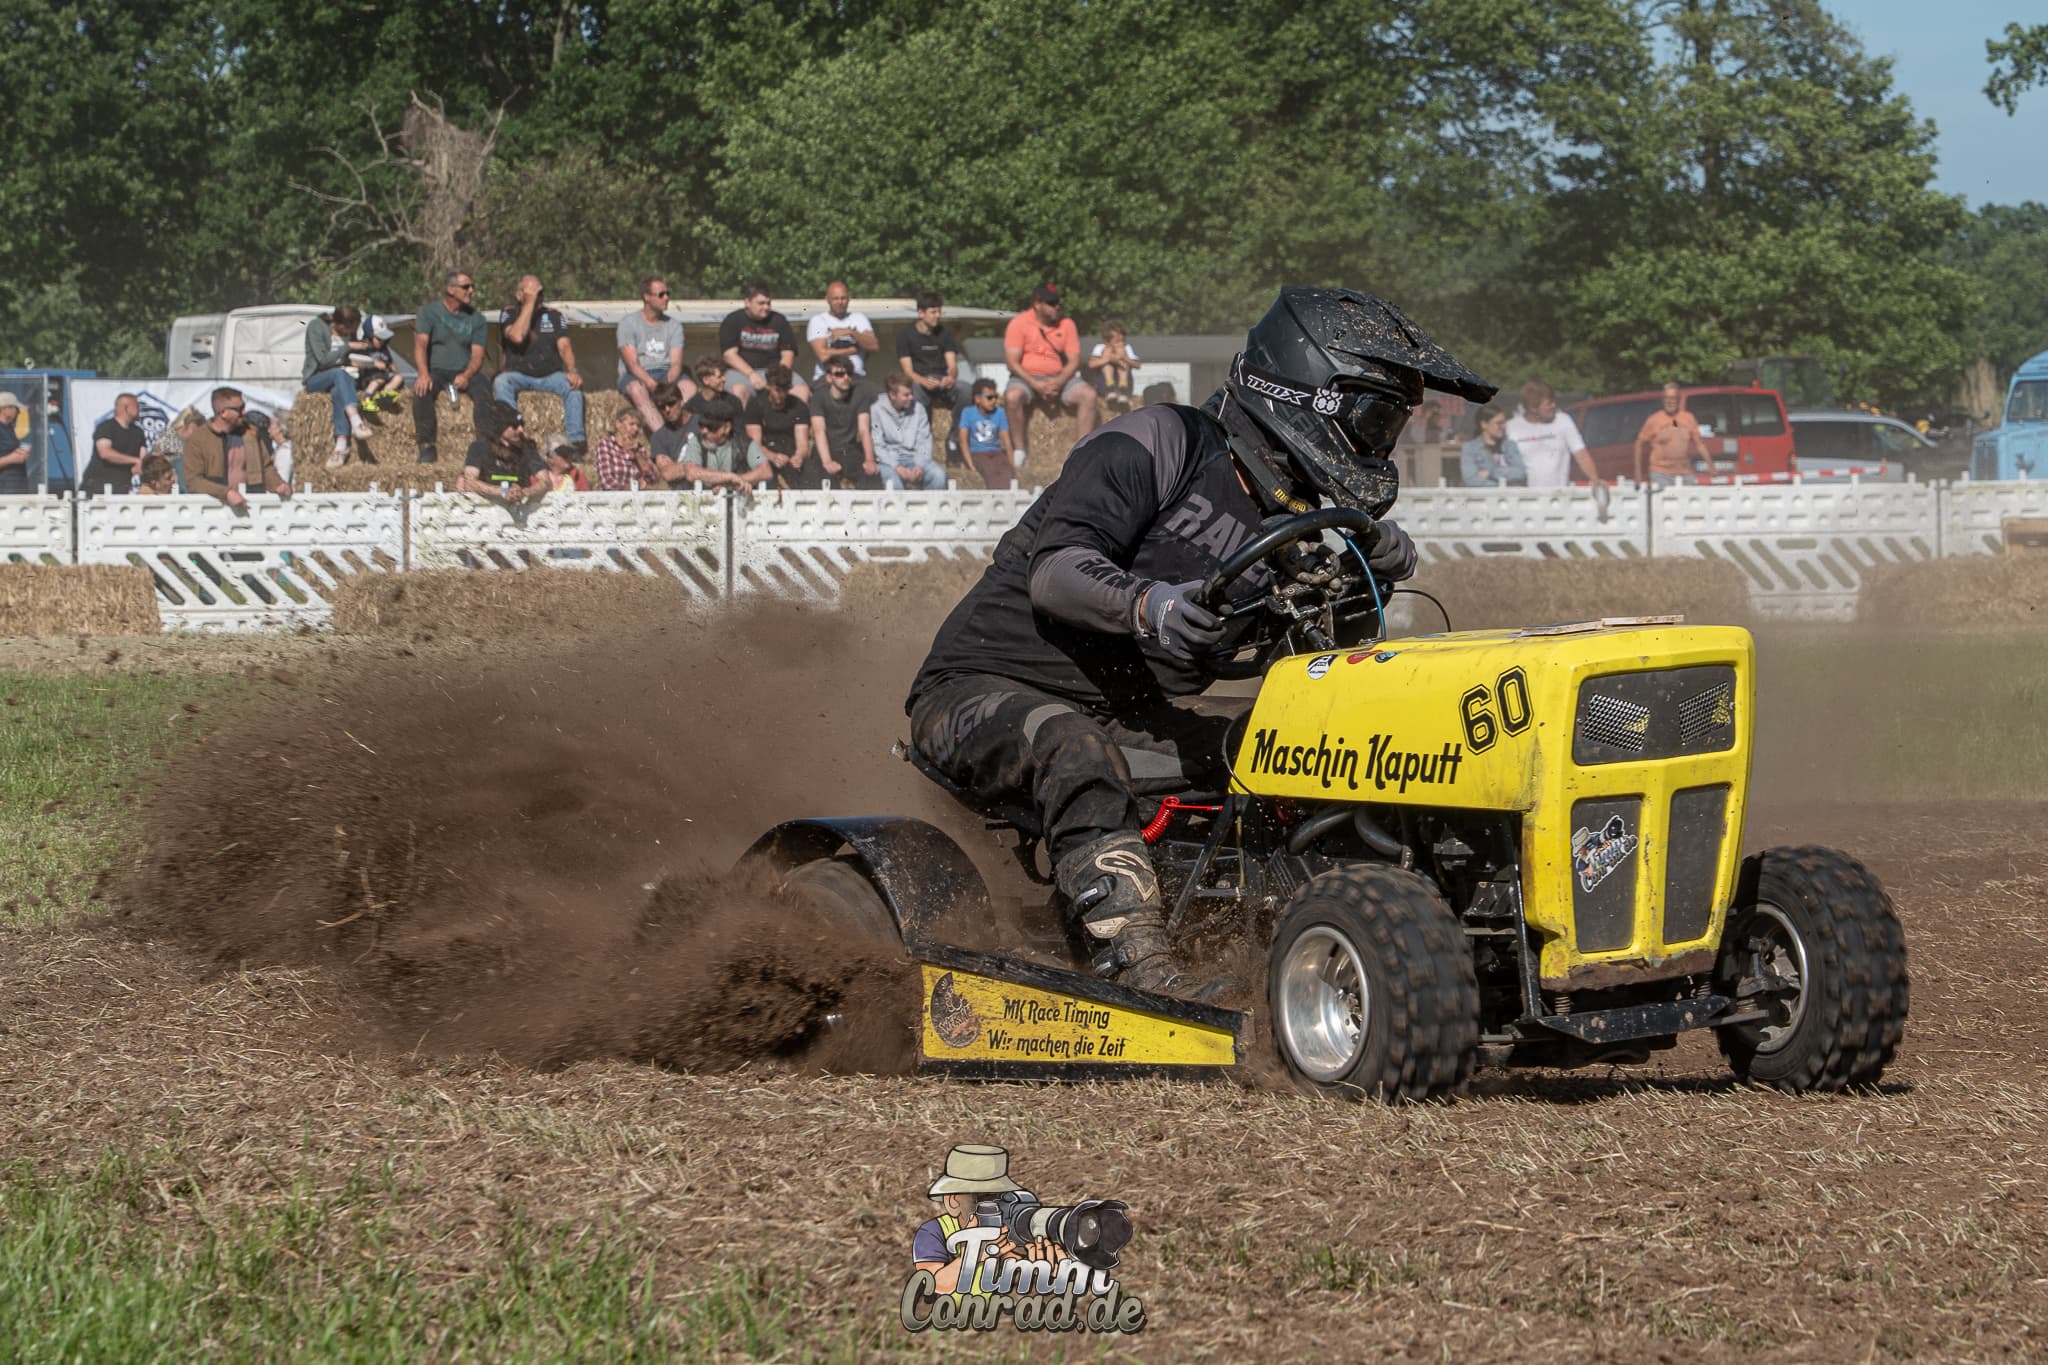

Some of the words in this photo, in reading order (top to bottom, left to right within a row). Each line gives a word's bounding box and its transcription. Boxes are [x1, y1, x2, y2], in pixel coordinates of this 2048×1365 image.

[1458, 665, 1535, 756] 60
[1250, 728, 1359, 790] Maschin
[1364, 733, 1463, 794] Kaputt
[1003, 999, 1025, 1025] MK
[1027, 1000, 1061, 1025] Race
[1063, 1001, 1111, 1030] Timing
[986, 1028, 1013, 1051] Wir
[1015, 1033, 1071, 1058] machen
[1073, 1035, 1095, 1057] die
[1098, 1035, 1127, 1057] Zeit
